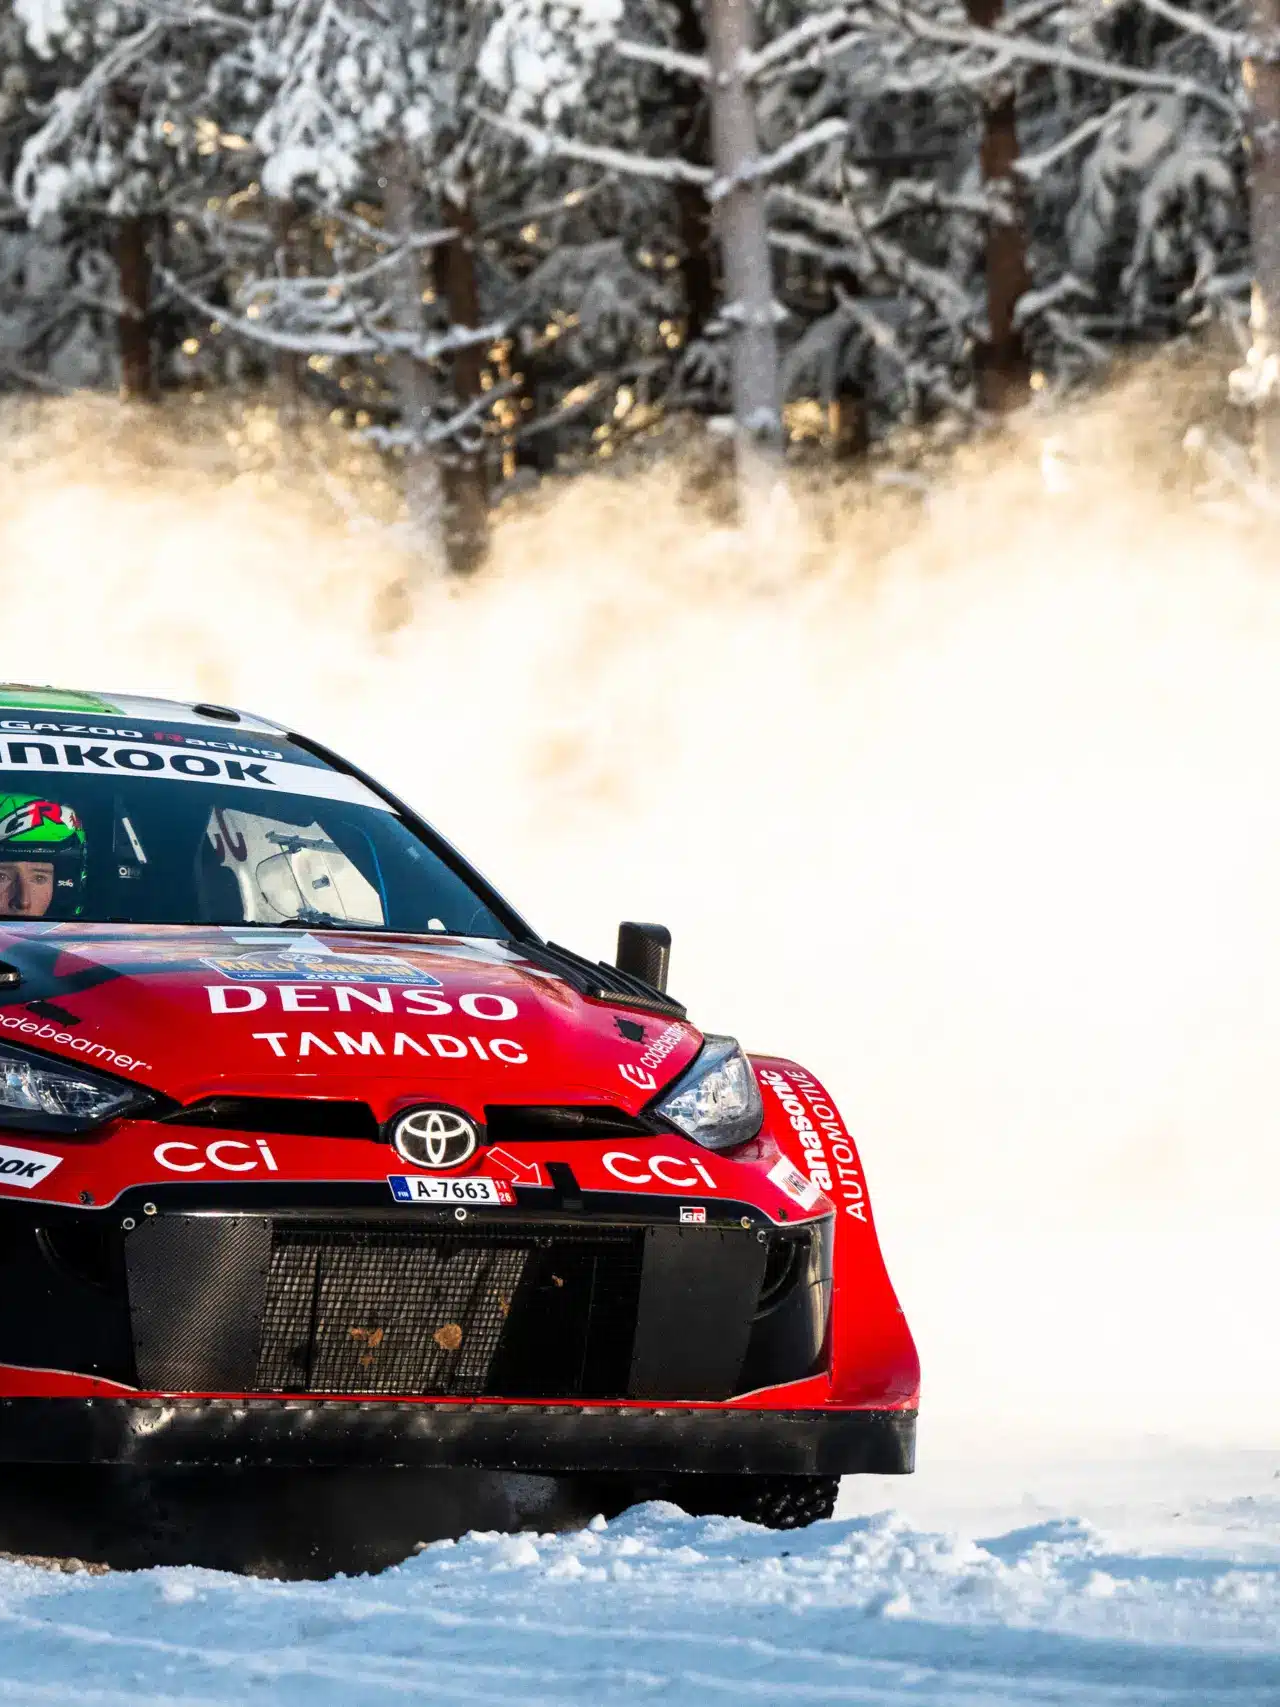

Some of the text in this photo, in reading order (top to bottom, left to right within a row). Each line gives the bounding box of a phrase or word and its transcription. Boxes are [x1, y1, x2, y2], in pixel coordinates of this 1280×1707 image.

[0, 720, 143, 739] GAZOO
[204, 985, 519, 1021] DENSO
[252, 1031, 529, 1065] TAMADIC
[760, 1069, 833, 1191] anasonic
[784, 1069, 868, 1223] AUTOMOTIVE
[417, 1180, 490, 1199] A-7663
